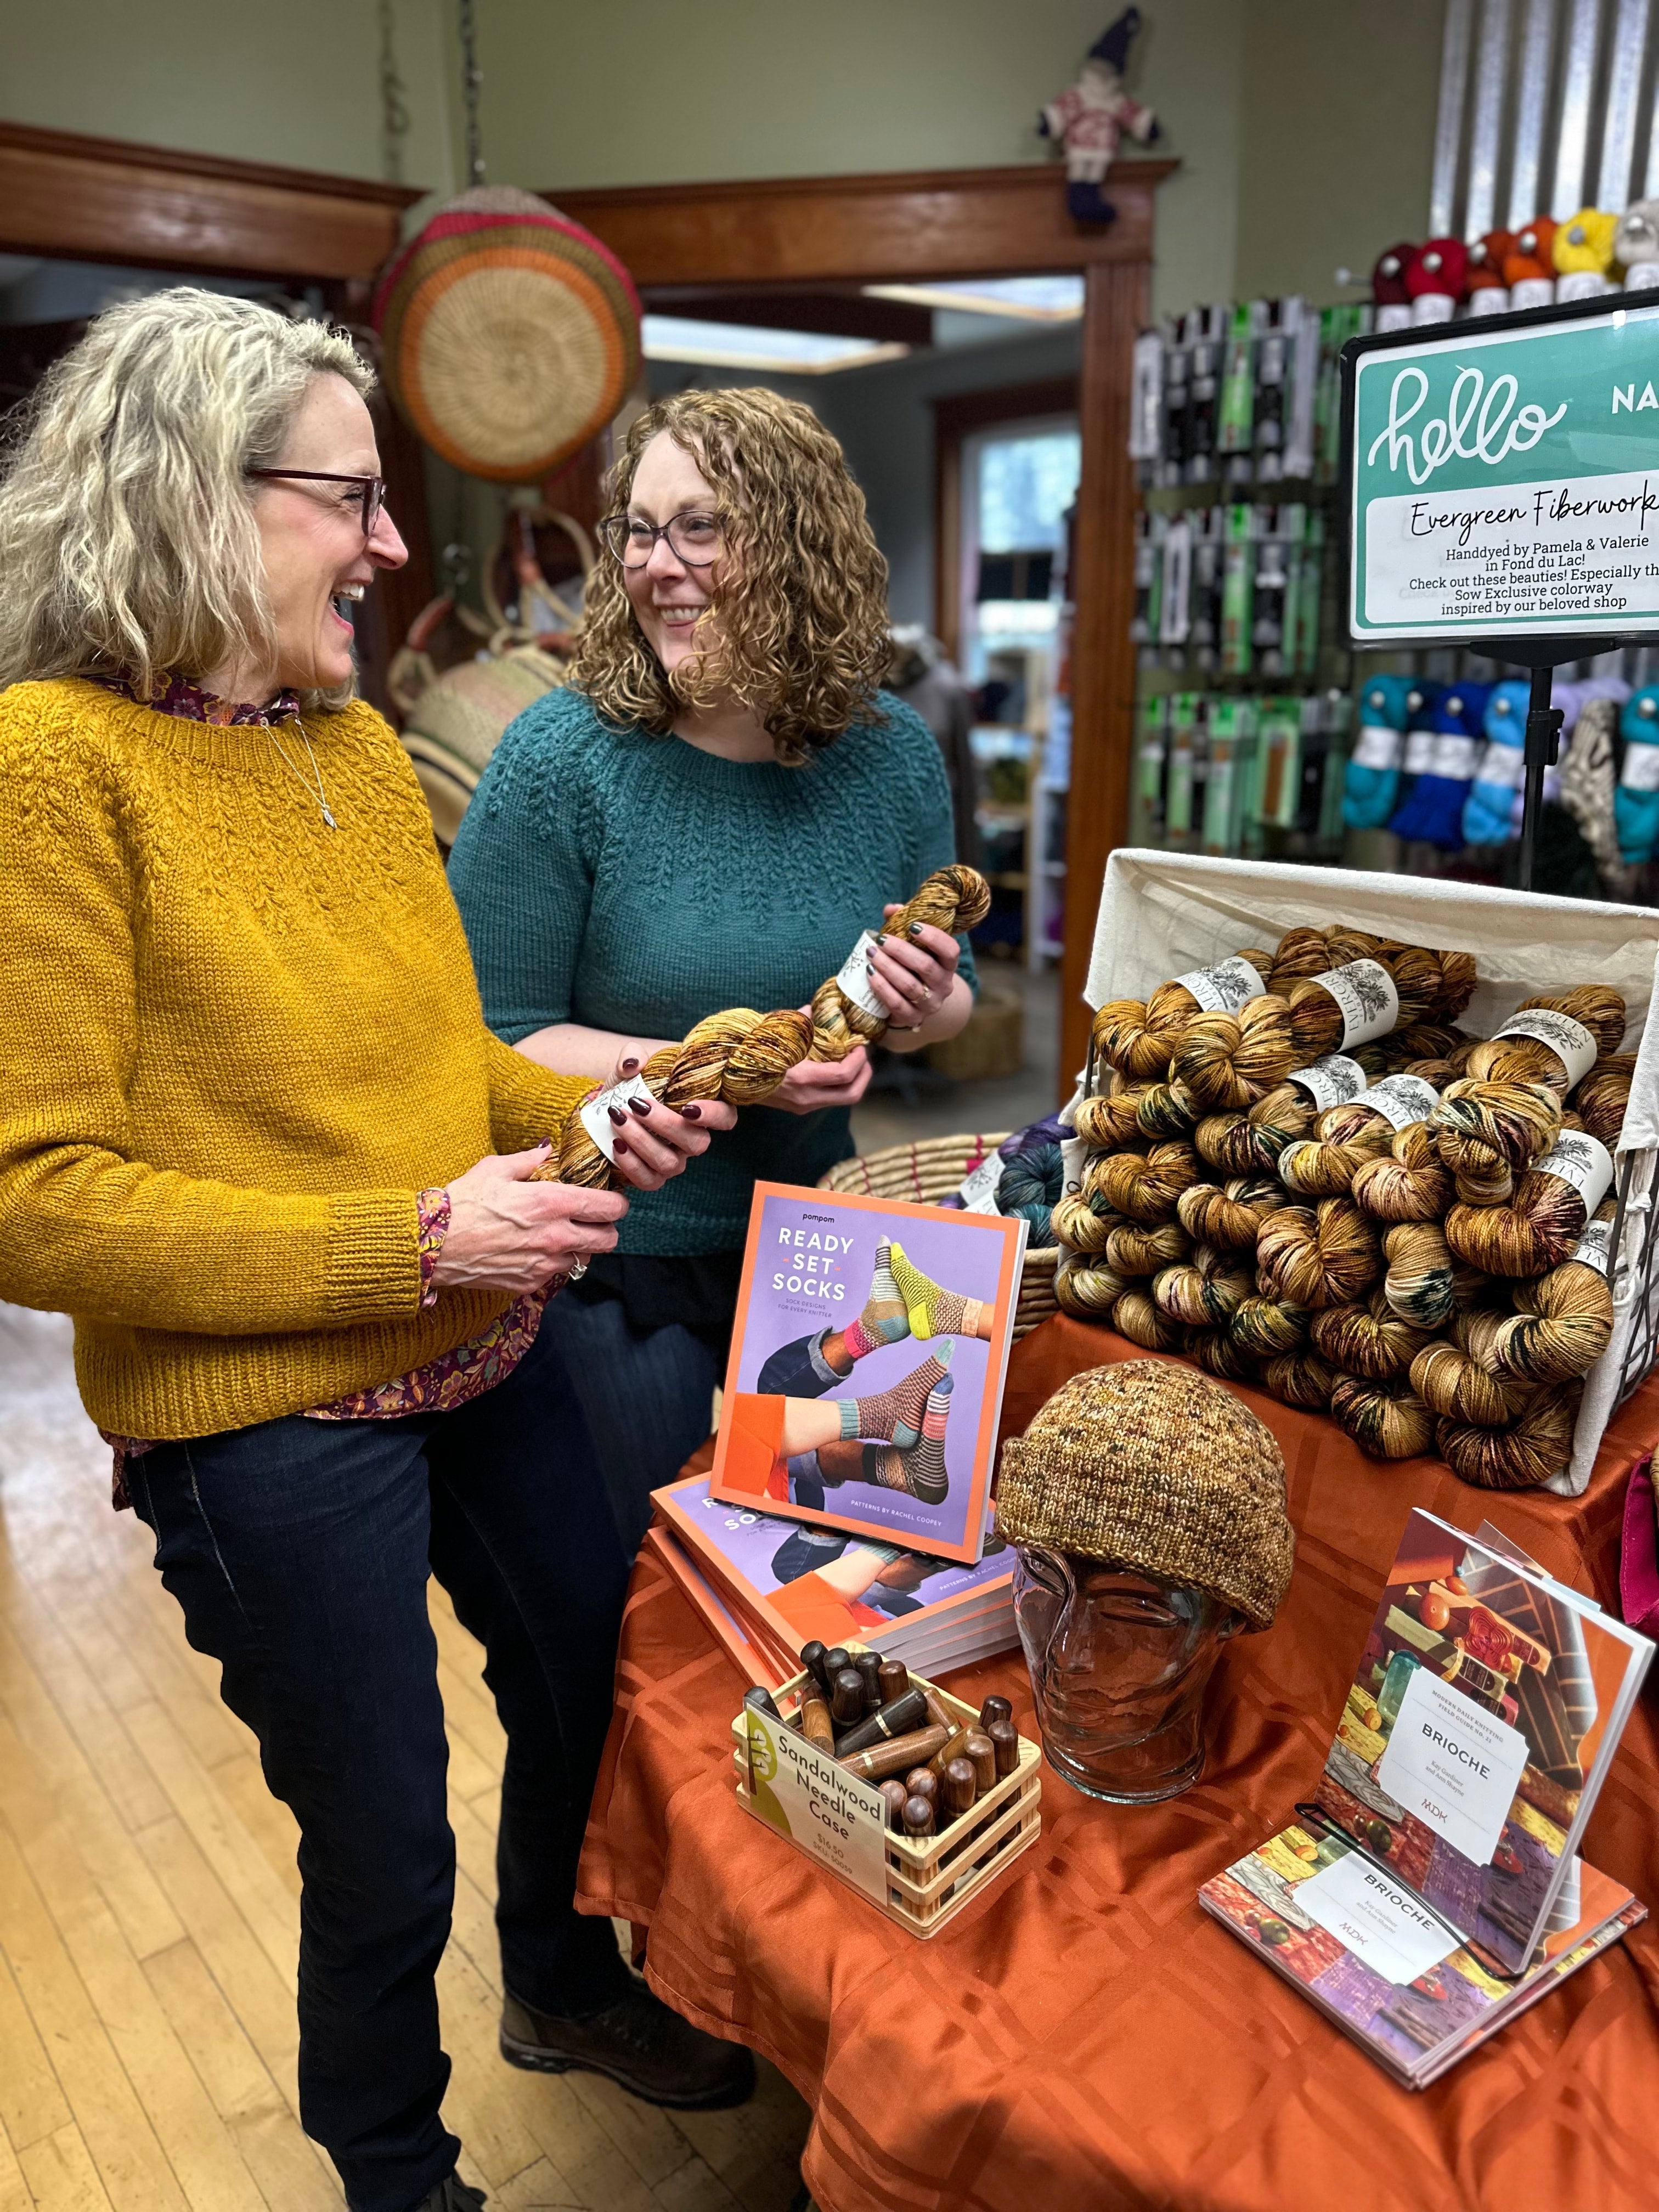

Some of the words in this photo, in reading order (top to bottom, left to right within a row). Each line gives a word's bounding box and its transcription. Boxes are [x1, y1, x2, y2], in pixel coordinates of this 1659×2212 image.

[1368, 366, 1568, 486] hello
[1412, 502, 1527, 546] Evergreen
[1446, 545, 1510, 560] Handdyed
[1514, 544, 1530, 557] by
[1533, 540, 1582, 554] Pamela
[1586, 539, 1595, 550] &
[1599, 534, 1649, 549] Valerie
[1485, 560, 1498, 572] in
[1502, 557, 1534, 571] Fond
[1538, 556, 1554, 568] du
[1558, 554, 1585, 567] Lac!
[1409, 577, 1447, 590] Check
[1450, 578, 1470, 588] out
[1473, 574, 1506, 586] these
[1510, 569, 1567, 584] beauties!
[1570, 565, 1641, 582] Especially
[1455, 590, 1481, 601] Sow
[1485, 585, 1547, 600] Exclusive
[1550, 583, 1613, 596] colorway
[1441, 601, 1492, 617] inspired
[1496, 601, 1511, 615] by
[1514, 602, 1536, 612] our
[1539, 596, 1590, 611] beloved
[1594, 596, 1627, 610] shop
[802, 1213, 834, 1223] pompom
[778, 1227, 854, 1254] READY
[792, 1253, 834, 1274] SET
[772, 1273, 845, 1301] SOCKS
[790, 1306, 808, 1314] EVERY
[809, 1310, 832, 1318] KNITTER
[802, 1301, 826, 1310] DESIGNS
[851, 1499, 880, 1512] PATTERNS
[891, 1509, 915, 1521] RACHEL
[916, 1516, 942, 1527] COOPEY
[1431, 1689, 1457, 1710] MODERN
[1457, 1706, 1475, 1722] DAILY
[1475, 1719, 1504, 1743] KNITTING
[1438, 1702, 1455, 1718] FIELD
[1455, 1715, 1474, 1731] GUIDE
[1474, 1729, 1485, 1739] NO.
[1485, 1735, 1492, 1744] 21
[1421, 1723, 1491, 1780] BRIOCHE
[778, 1735, 881, 1821] Sandalwood
[1425, 1765, 1436, 1776] and
[1435, 1773, 1447, 1785] Ann
[1446, 1780, 1465, 1797] Shayne
[1431, 1759, 1442, 1773] Kay
[1441, 1767, 1464, 1787] Gardiner
[797, 1768, 856, 1825] Needle
[809, 1800, 850, 1840] Case
[1421, 1798, 1448, 1824] MDK
[817, 1833, 844, 1859] $16.50
[1356, 1901, 1368, 1912] and
[1364, 1874, 1436, 1931] BRIOCHE
[1364, 1900, 1376, 1910] Kay
